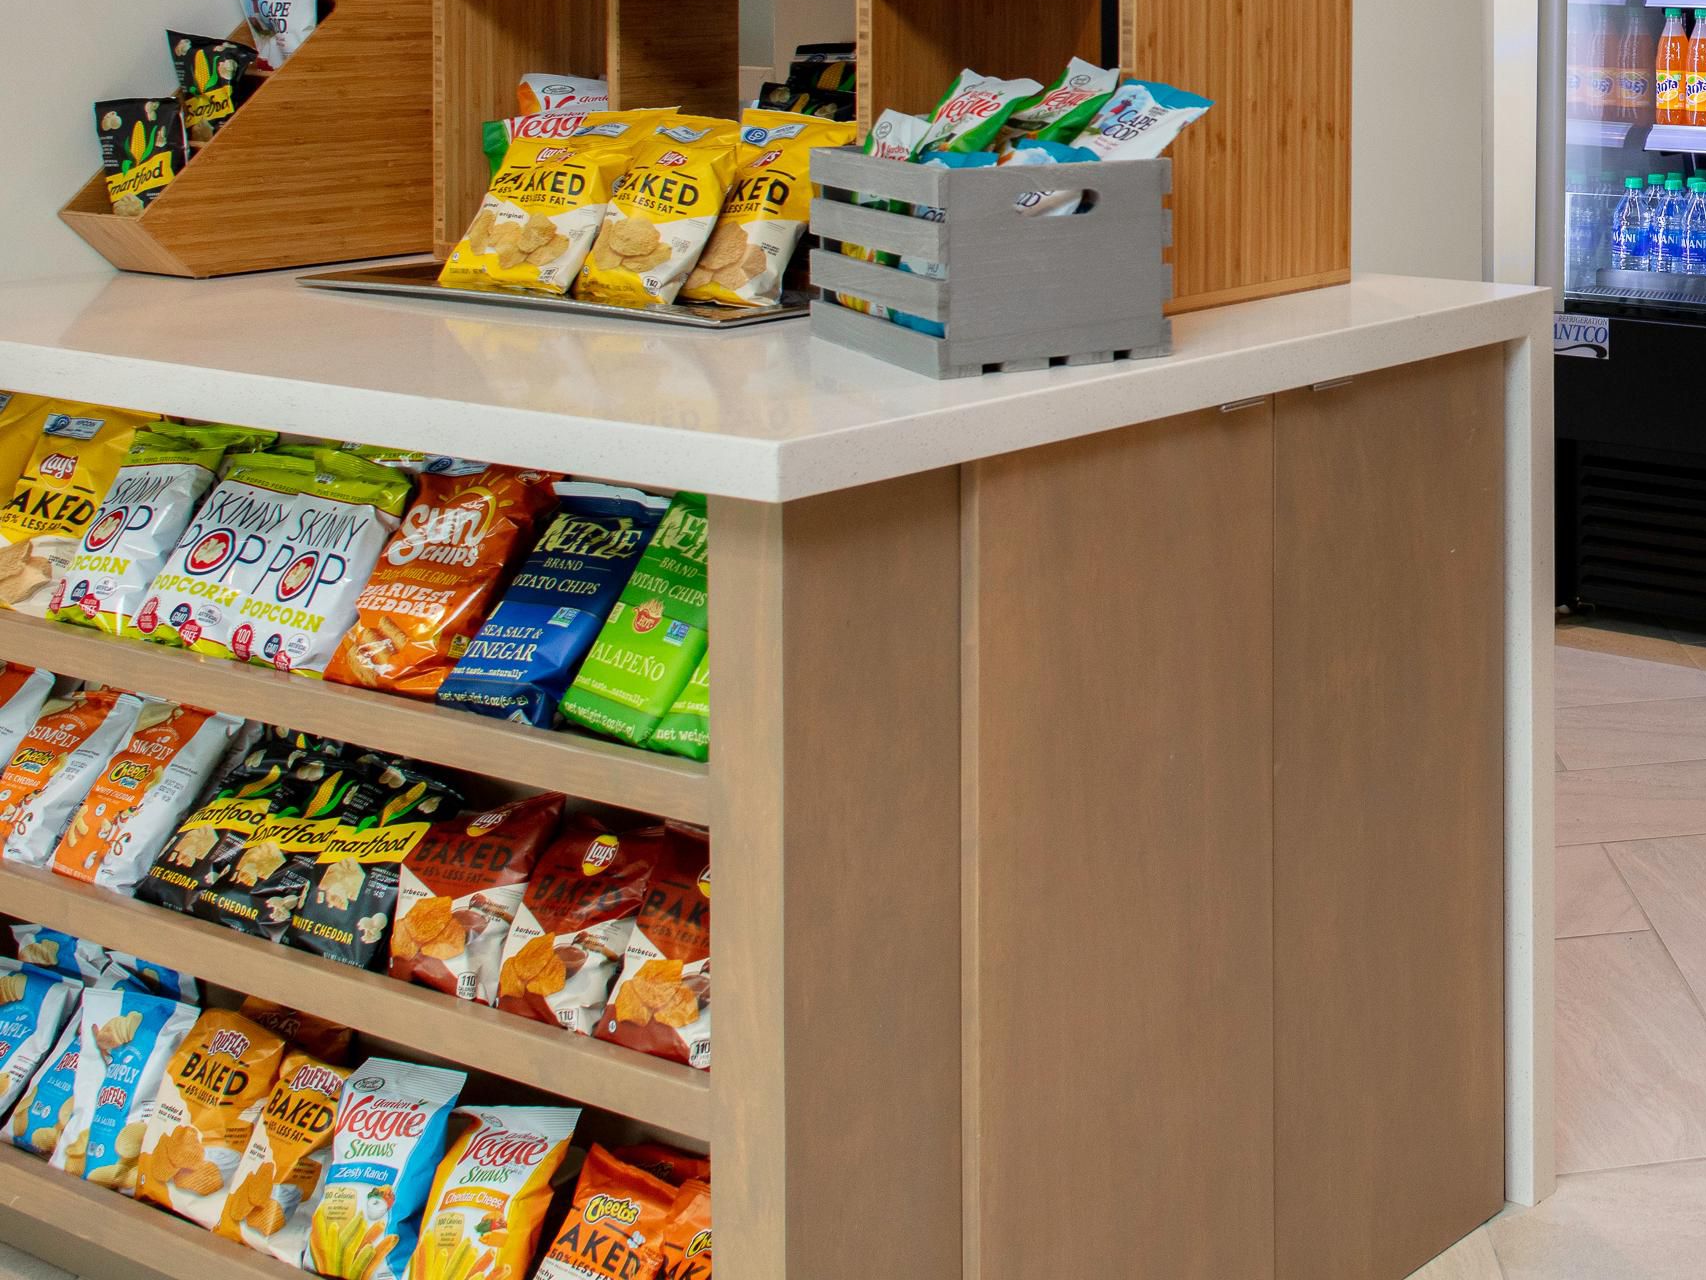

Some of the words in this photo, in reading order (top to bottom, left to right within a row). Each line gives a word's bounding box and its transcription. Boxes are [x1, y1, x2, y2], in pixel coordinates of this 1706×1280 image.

[260, 1, 291, 18] CAPE
[1117, 110, 1157, 131] CAPE
[1102, 124, 1139, 141] COD
[549, 195, 566, 206] FAT
[632, 197, 656, 209] LESS
[657, 202, 675, 214] FAT
[743, 202, 761, 213] FAT
[498, 211, 525, 219] original
[40, 453, 76, 479] Lay's
[102, 472, 175, 505] SKINNY
[200, 490, 292, 534] SKINNY
[21, 517, 47, 531] LESS
[286, 507, 369, 552] SKINNY
[387, 504, 484, 566] Sun
[534, 512, 643, 559] KETTLE
[178, 523, 266, 583] POP
[419, 545, 480, 567] CHIPS
[544, 557, 583, 571] BRAND
[252, 544, 347, 608] POP
[659, 557, 698, 578] BRAND
[431, 572, 460, 586] GRAIN
[558, 579, 601, 595] CHIPS
[153, 575, 240, 606] POPCORN
[668, 584, 708, 608] CHIPS
[239, 598, 325, 633] POPCORN
[481, 624, 502, 638] SEA
[503, 625, 532, 639] SALT
[532, 629, 543, 639] &
[463, 641, 538, 663] VINEGAR
[28, 725, 80, 748] SIMPLY
[657, 728, 677, 740] net
[129, 739, 174, 761] SIMPLY
[110, 761, 151, 782] Cheetos
[326, 831, 415, 855] martfood
[587, 841, 615, 866] Lay's
[415, 839, 513, 871] BAKED
[162, 868, 198, 891] CHEDDAR
[533, 875, 622, 910] BAKED
[218, 894, 259, 921] CHEDDAR
[315, 920, 353, 946] CHEDDAR
[515, 926, 542, 936] barbecue
[627, 945, 658, 958] barbecue
[461, 975, 476, 987] 110
[558, 1010, 573, 1022] 110
[208, 1029, 250, 1060] RUFFLES
[695, 1041, 710, 1055] 110
[180, 1052, 249, 1096] BAKED
[290, 1065, 343, 1097] RUFFLES
[98, 1086, 128, 1111] RUFFLES
[371, 1098, 411, 1110] garden
[267, 1088, 334, 1133] BAKED
[335, 1092, 427, 1142] Veggie
[276, 1123, 291, 1137] LESS
[289, 1129, 303, 1143] FAT
[344, 1139, 396, 1160] Straws
[457, 1126, 549, 1167] Veggie
[334, 1167, 362, 1179] Zesty
[363, 1167, 389, 1181] Ranch
[460, 1166, 511, 1184] Straws
[444, 1191, 473, 1205] Cheddar
[473, 1191, 505, 1209] Cheese
[584, 1194, 641, 1226] Cheetos
[571, 1257, 595, 1277] LESS
